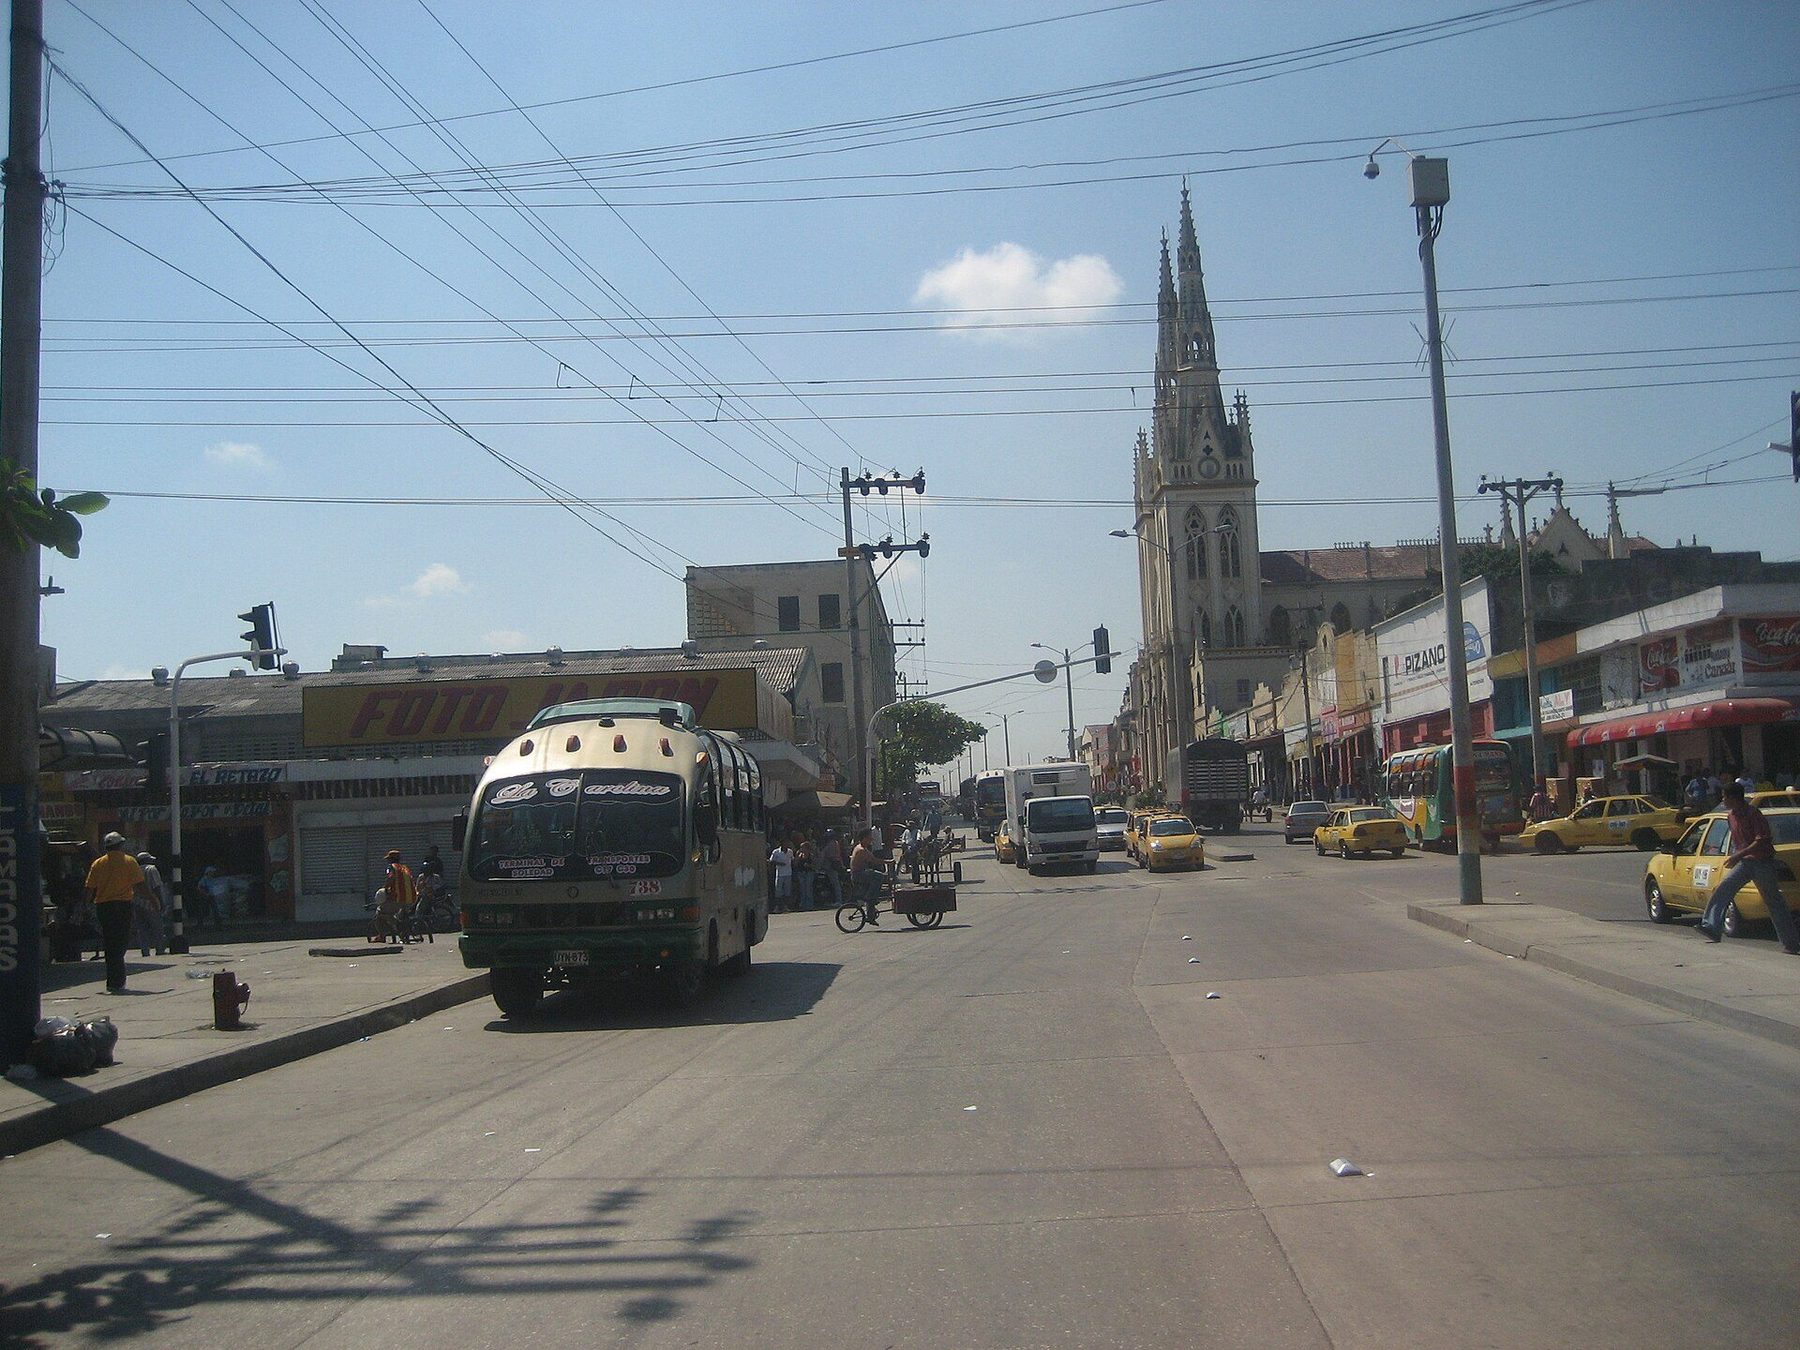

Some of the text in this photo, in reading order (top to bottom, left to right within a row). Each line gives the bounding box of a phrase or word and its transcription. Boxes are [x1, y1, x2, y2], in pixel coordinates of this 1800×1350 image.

[1405, 644, 1446, 675] PIZANO
[349, 684, 509, 738] FOTO
[498, 857, 566, 869] TERMINAL DE
[512, 868, 554, 878] SOLEDAD
